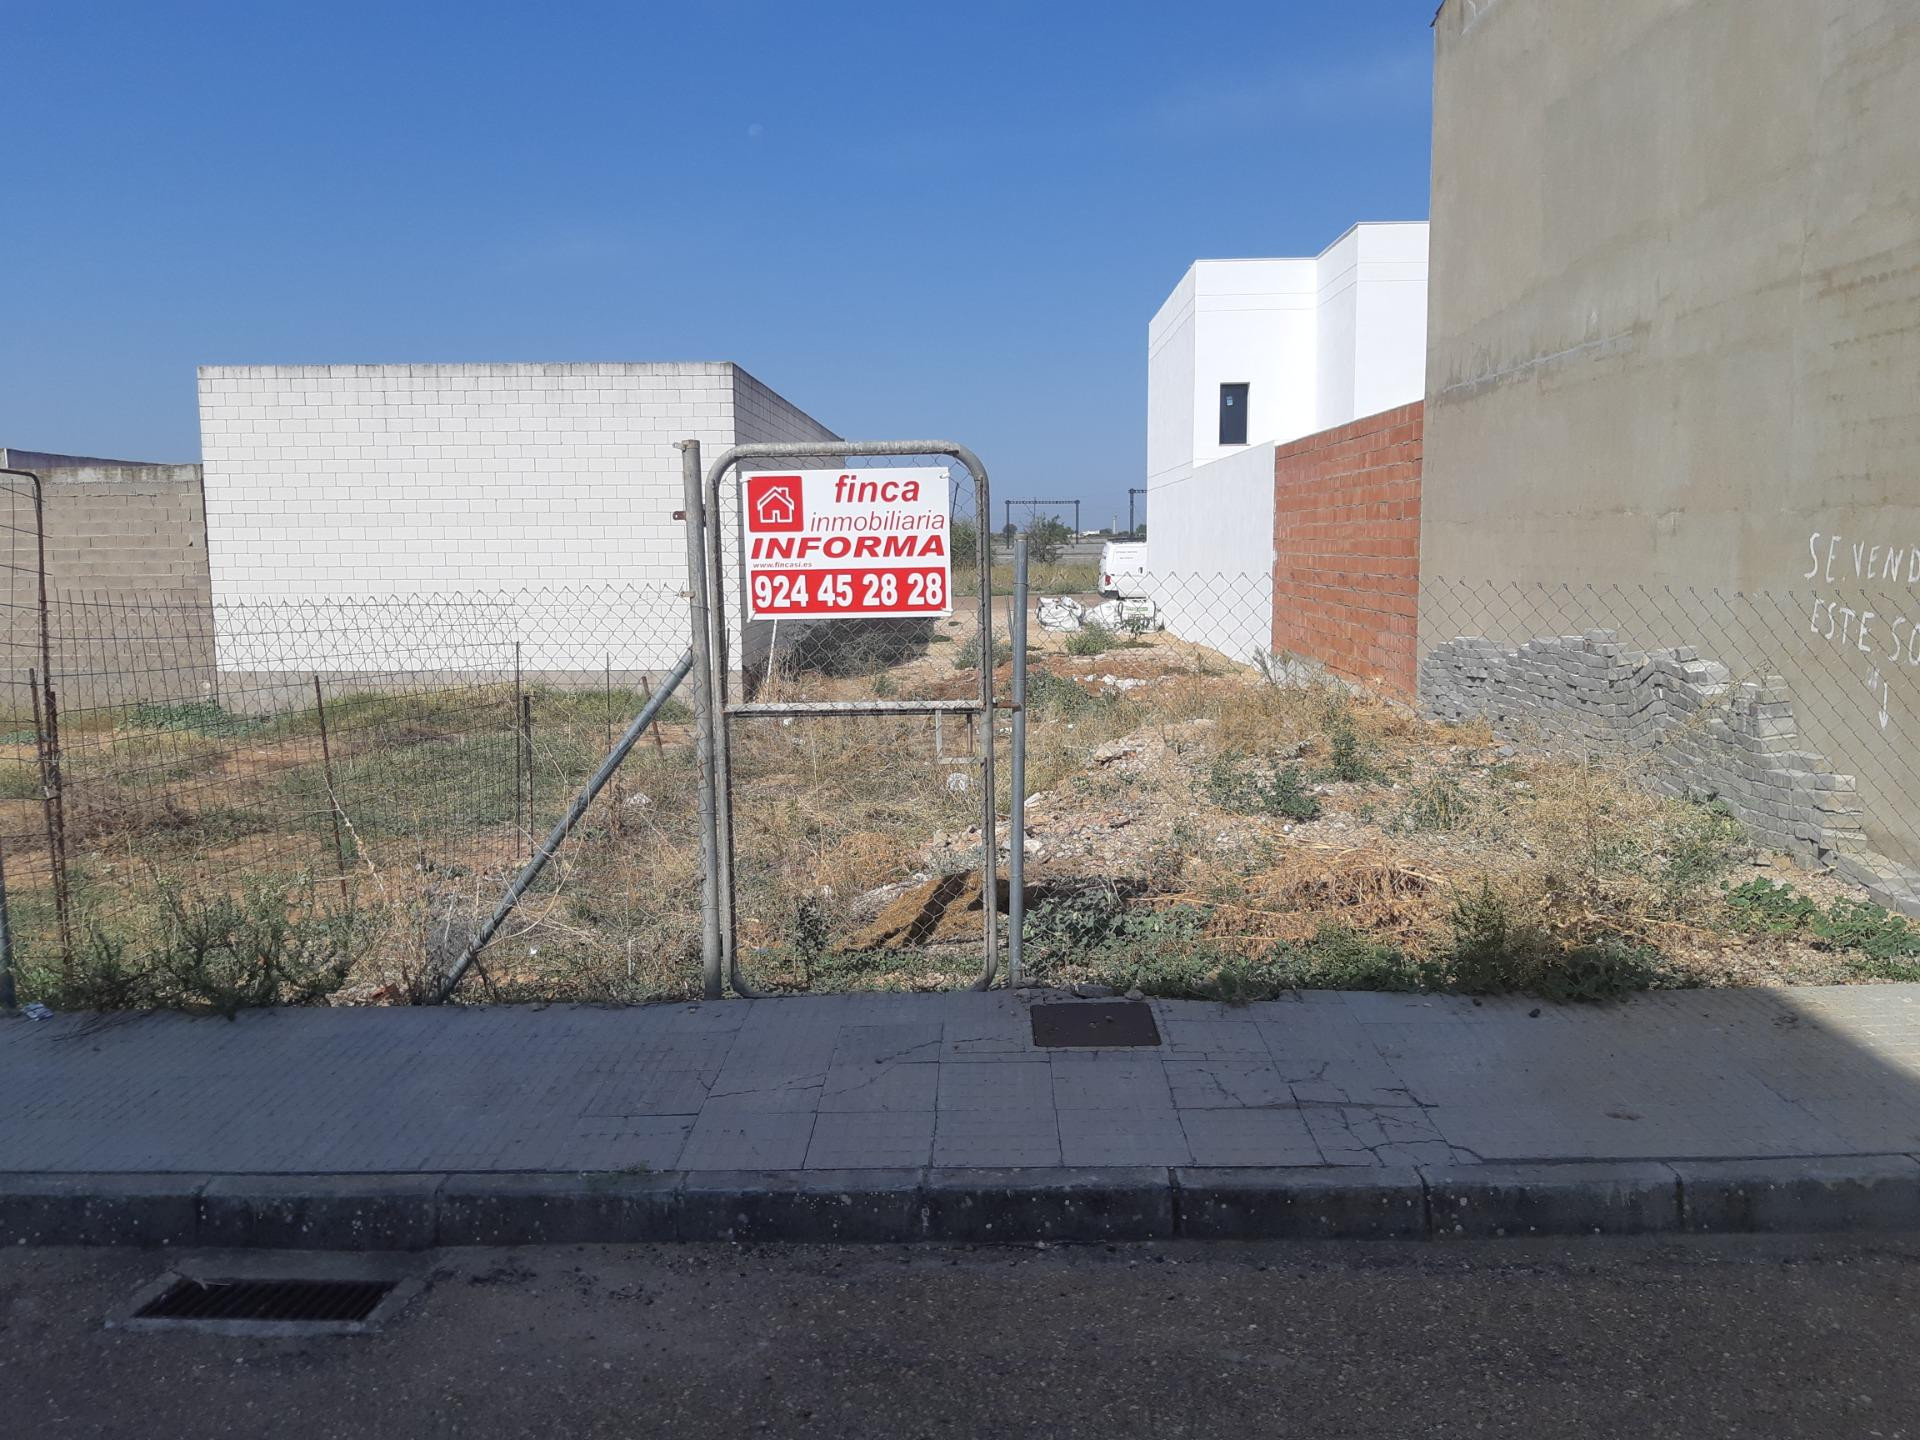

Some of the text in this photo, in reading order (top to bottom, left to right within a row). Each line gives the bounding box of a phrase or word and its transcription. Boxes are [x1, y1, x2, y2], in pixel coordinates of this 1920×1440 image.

[835, 475, 920, 503] finca
[810, 509, 945, 532] inmobiliaria
[751, 535, 945, 559] INFORMA
[1804, 532, 1842, 583] SE
[752, 561, 813, 569] www.fincasi.es
[755, 572, 943, 608] 924 45 28 28
[1810, 599, 1875, 652] ESTE
